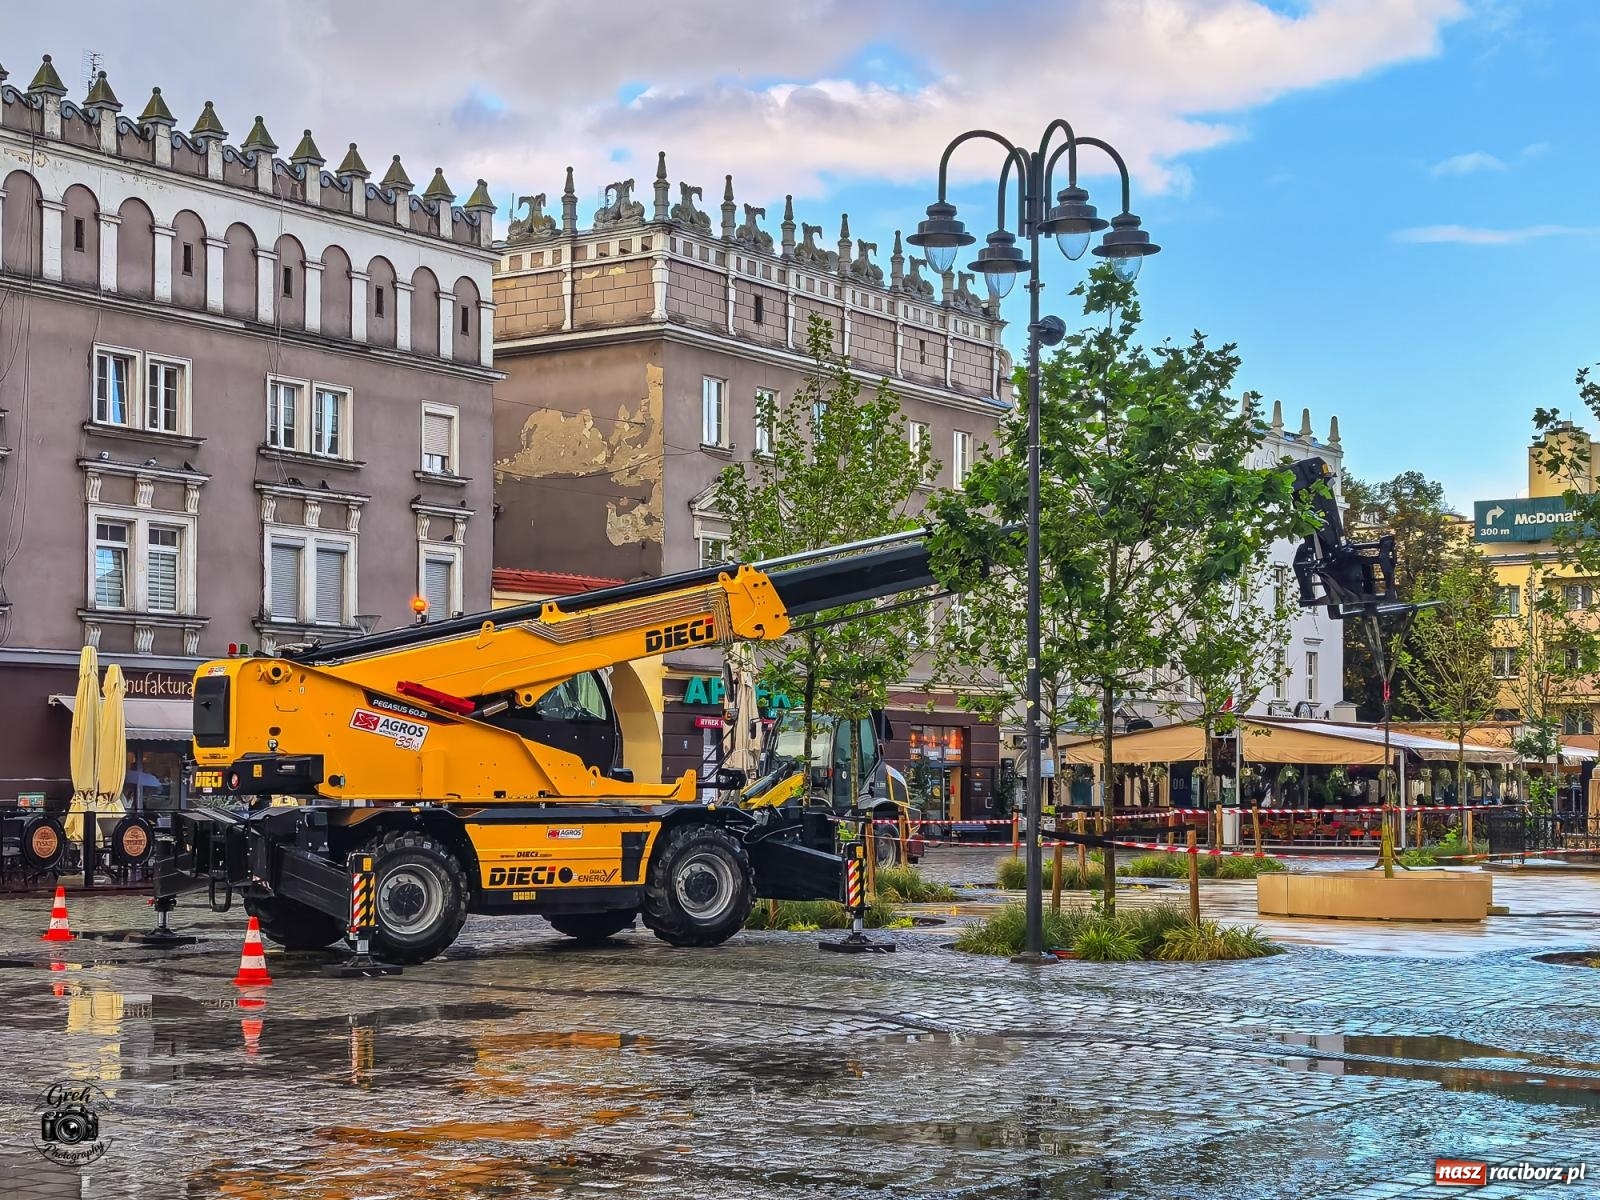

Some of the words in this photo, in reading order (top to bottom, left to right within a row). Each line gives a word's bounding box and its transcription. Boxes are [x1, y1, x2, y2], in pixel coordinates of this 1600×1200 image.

[1480, 528, 1498, 536] 300
[126, 672, 194, 697] nufaktura
[373, 699, 408, 714] PEGASUS
[408, 708, 428, 718] 60.21
[380, 718, 425, 738] AGROS
